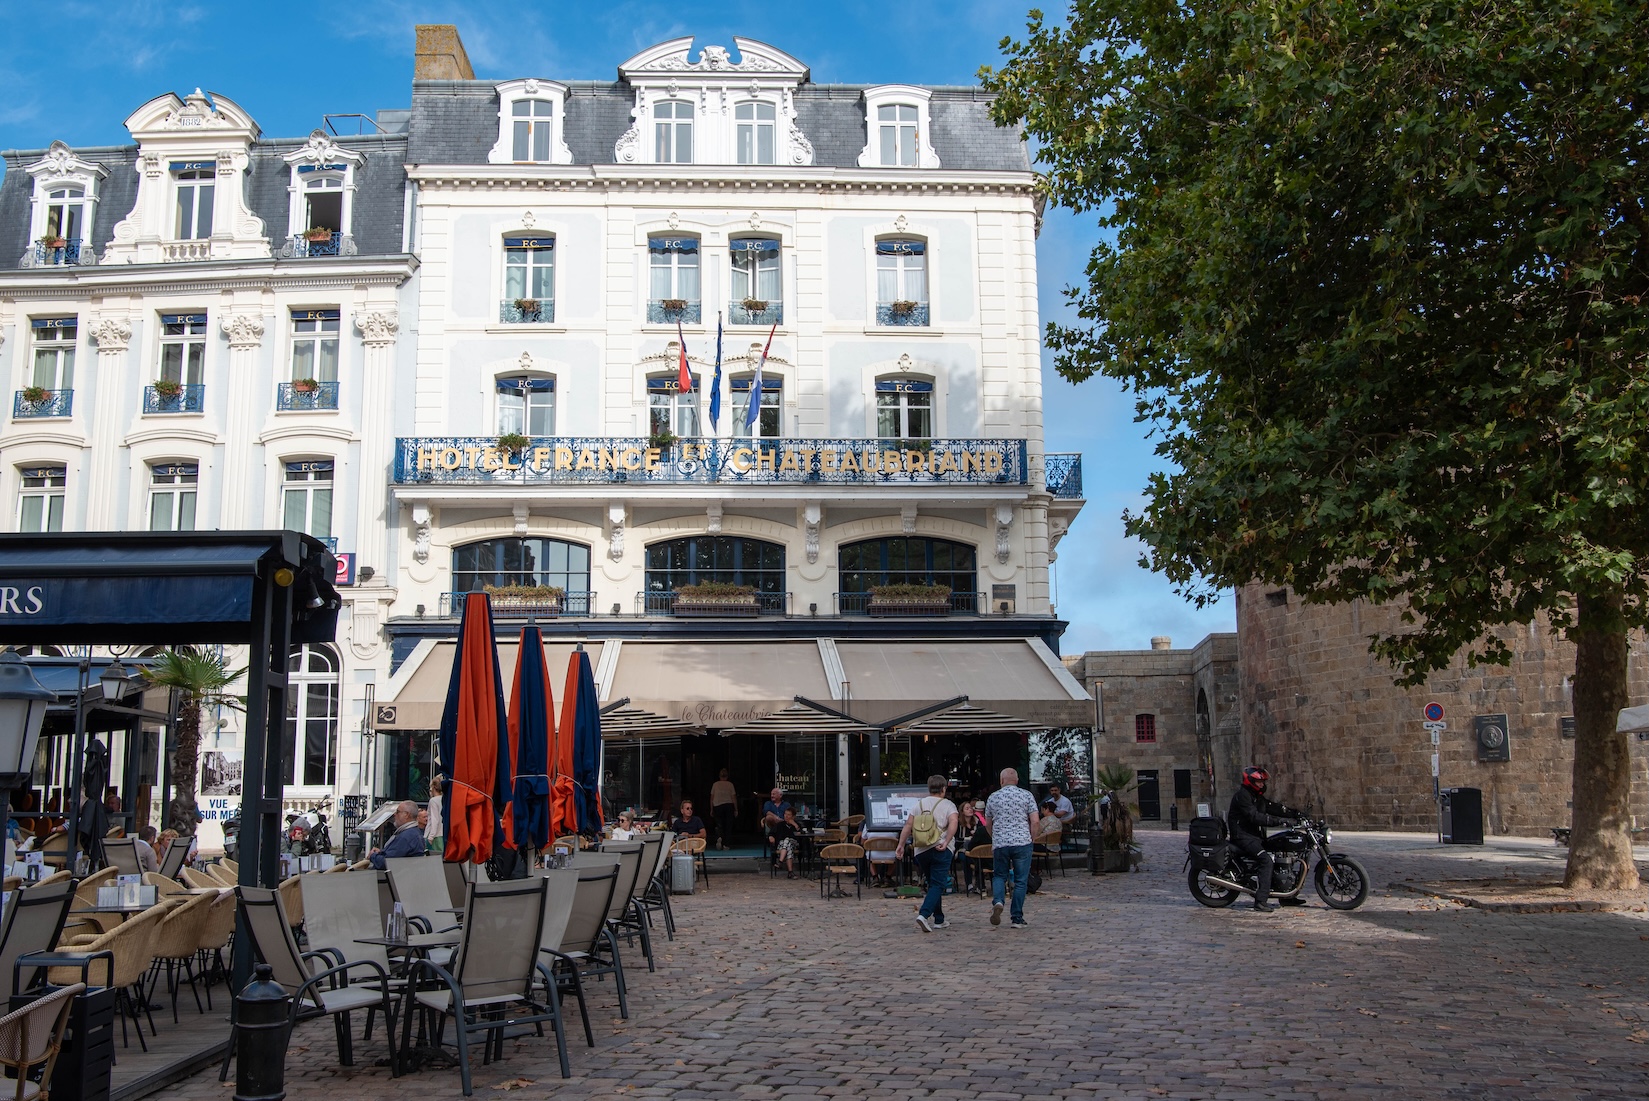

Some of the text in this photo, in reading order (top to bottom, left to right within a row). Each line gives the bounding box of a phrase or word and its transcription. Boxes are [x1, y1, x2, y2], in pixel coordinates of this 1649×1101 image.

[417, 444, 1003, 473] HOTEL FRANCE ET CHATEAUBRIAND
[210, 799, 228, 808] VUE
[200, 810, 236, 820] SUR ME
